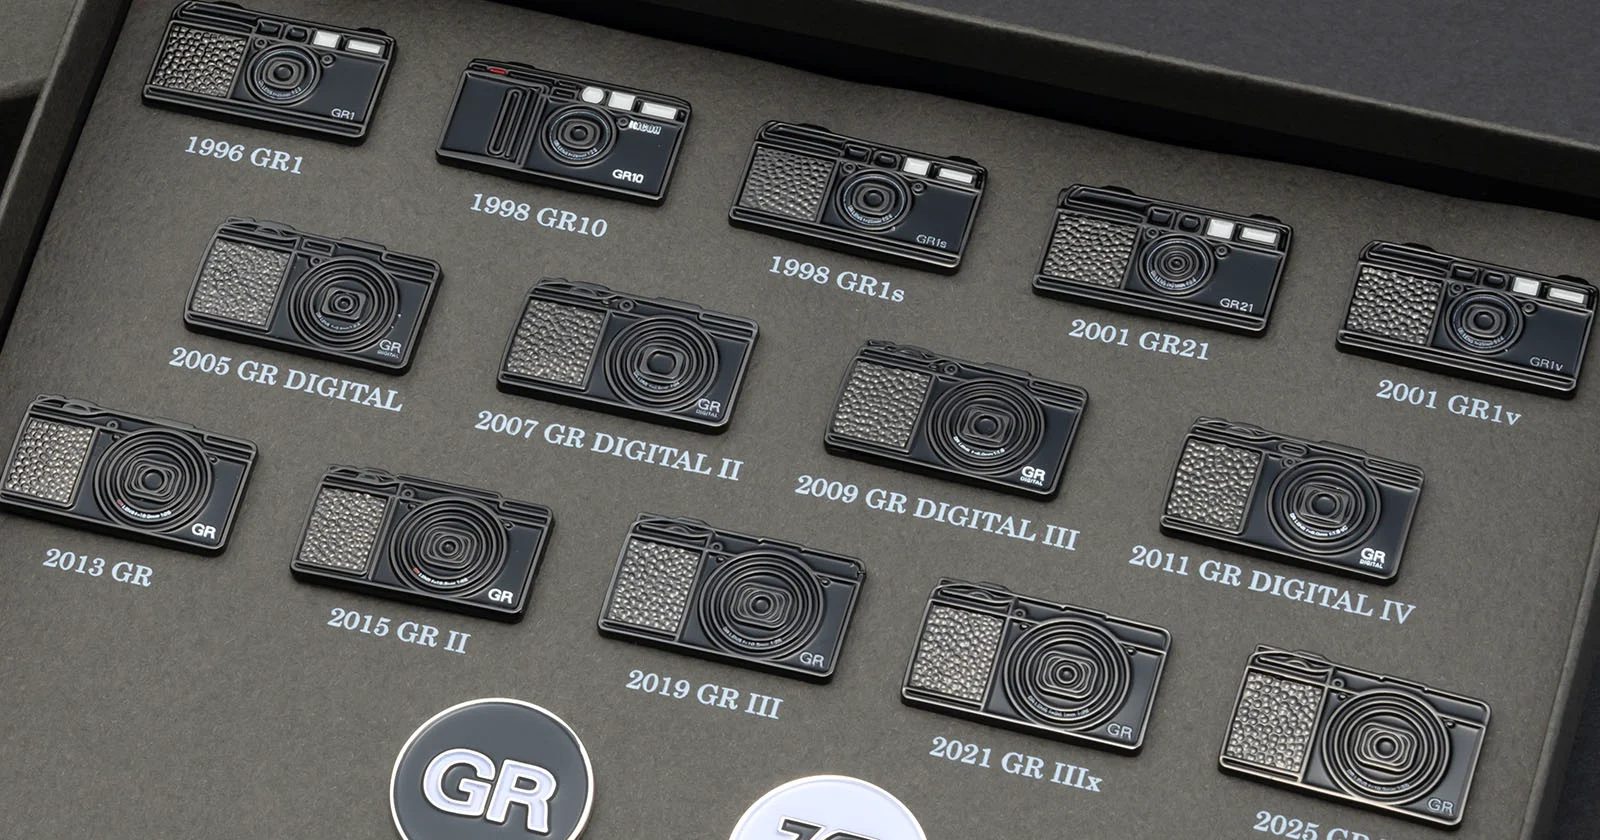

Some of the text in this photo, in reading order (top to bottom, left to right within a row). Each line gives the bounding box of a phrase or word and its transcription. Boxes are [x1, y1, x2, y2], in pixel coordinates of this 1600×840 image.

[331, 109, 354, 121] GR1
[186, 137, 302, 174] 1996 GR1
[613, 169, 643, 183] GR10
[471, 194, 607, 237] 1998 GR10
[915, 235, 946, 249] GR1s
[770, 256, 904, 302] 1998 GR1s
[1218, 298, 1253, 313] GR21
[378, 340, 401, 355] GR
[1069, 320, 1208, 360] 2001 GR21
[169, 347, 402, 411] 2005 GR DIGITAL
[1528, 357, 1563, 372] GR1v
[696, 397, 720, 414] GR
[1377, 380, 1521, 425] 2001 GR1v
[475, 411, 743, 480] 2007 GR DIGITAL II
[1020, 466, 1045, 481] GR
[795, 475, 1080, 550] 2009 GR DIGITAL III
[191, 522, 216, 539] GR
[43, 549, 152, 586] 2013 GR
[1360, 548, 1385, 564] GR
[488, 589, 513, 603] GR
[1129, 546, 1416, 624] 2011 GR DIGITAL IV
[328, 608, 471, 653] 2015 GR II
[798, 651, 824, 667] GR
[626, 670, 783, 719] 2019 GR III
[1107, 723, 1132, 739] GR
[930, 737, 1102, 792] 2021 GR IIIx
[424, 749, 556, 836] GR
[1428, 799, 1453, 814] GR
[1254, 811, 1319, 840] 2025
